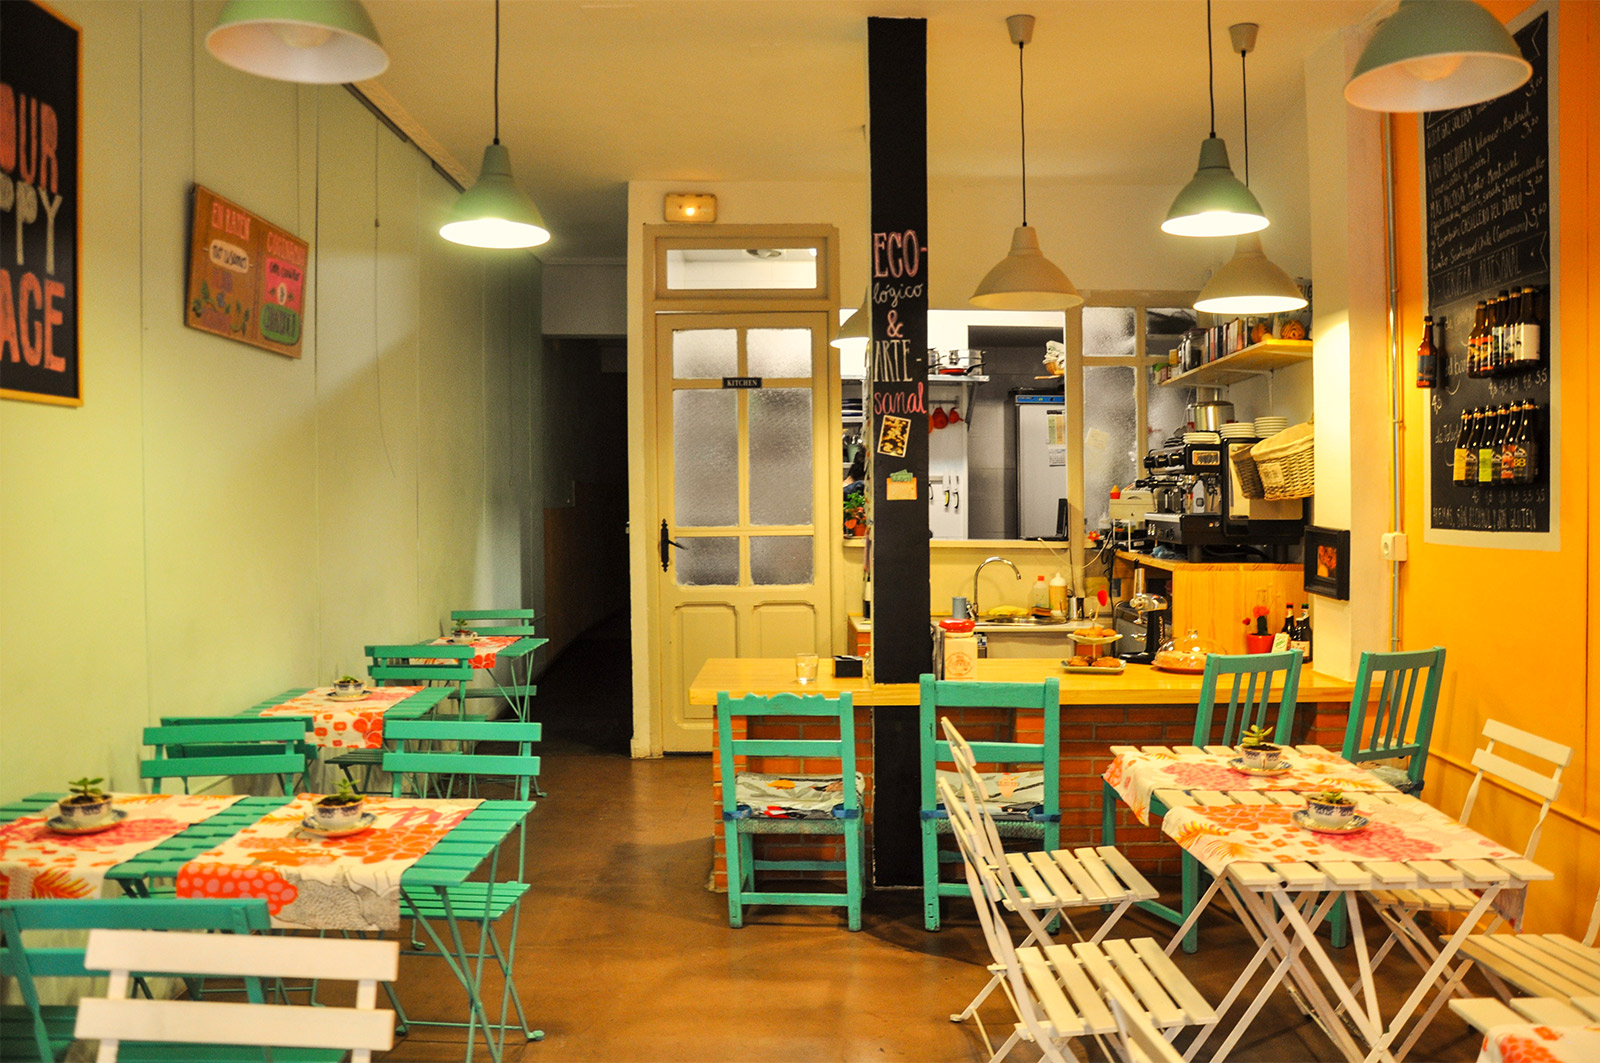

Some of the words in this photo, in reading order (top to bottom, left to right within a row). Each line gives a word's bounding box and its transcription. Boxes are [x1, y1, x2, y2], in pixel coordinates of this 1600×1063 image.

[873, 229, 928, 278] ECO-
[873, 282, 923, 308] lógico
[886, 309, 904, 338] &
[873, 381, 928, 414] sanal
